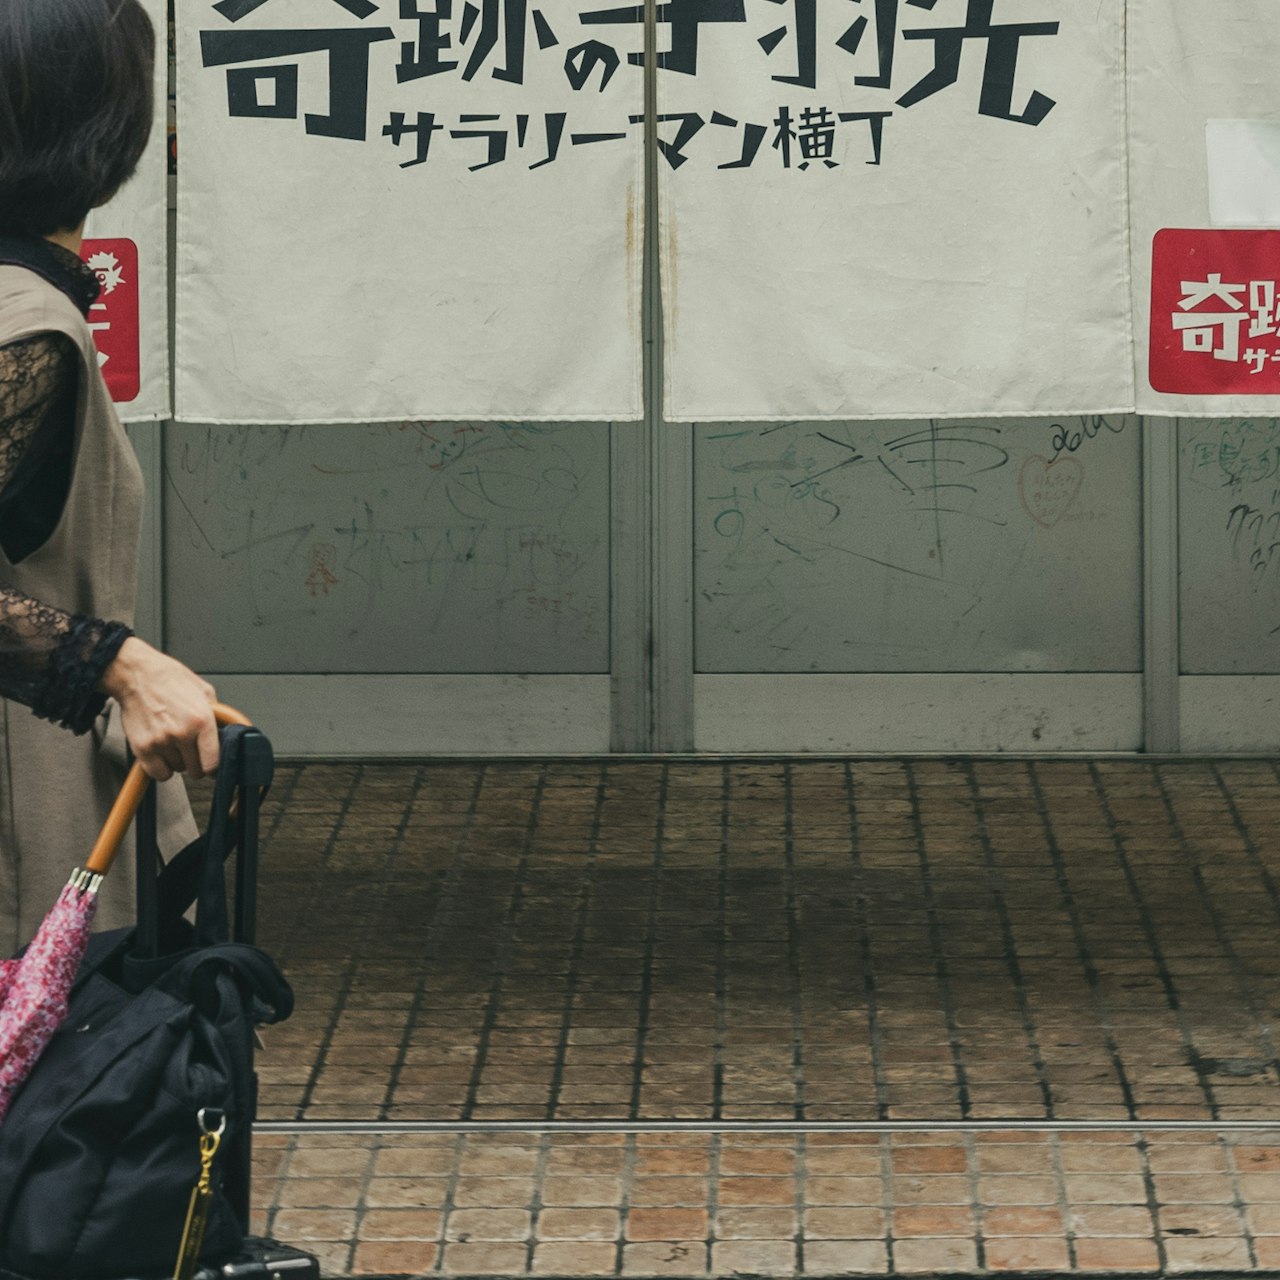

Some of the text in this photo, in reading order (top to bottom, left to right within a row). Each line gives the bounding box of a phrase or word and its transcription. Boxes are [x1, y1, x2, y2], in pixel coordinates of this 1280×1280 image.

[381, 105, 895, 171] サラリーマン横丁
